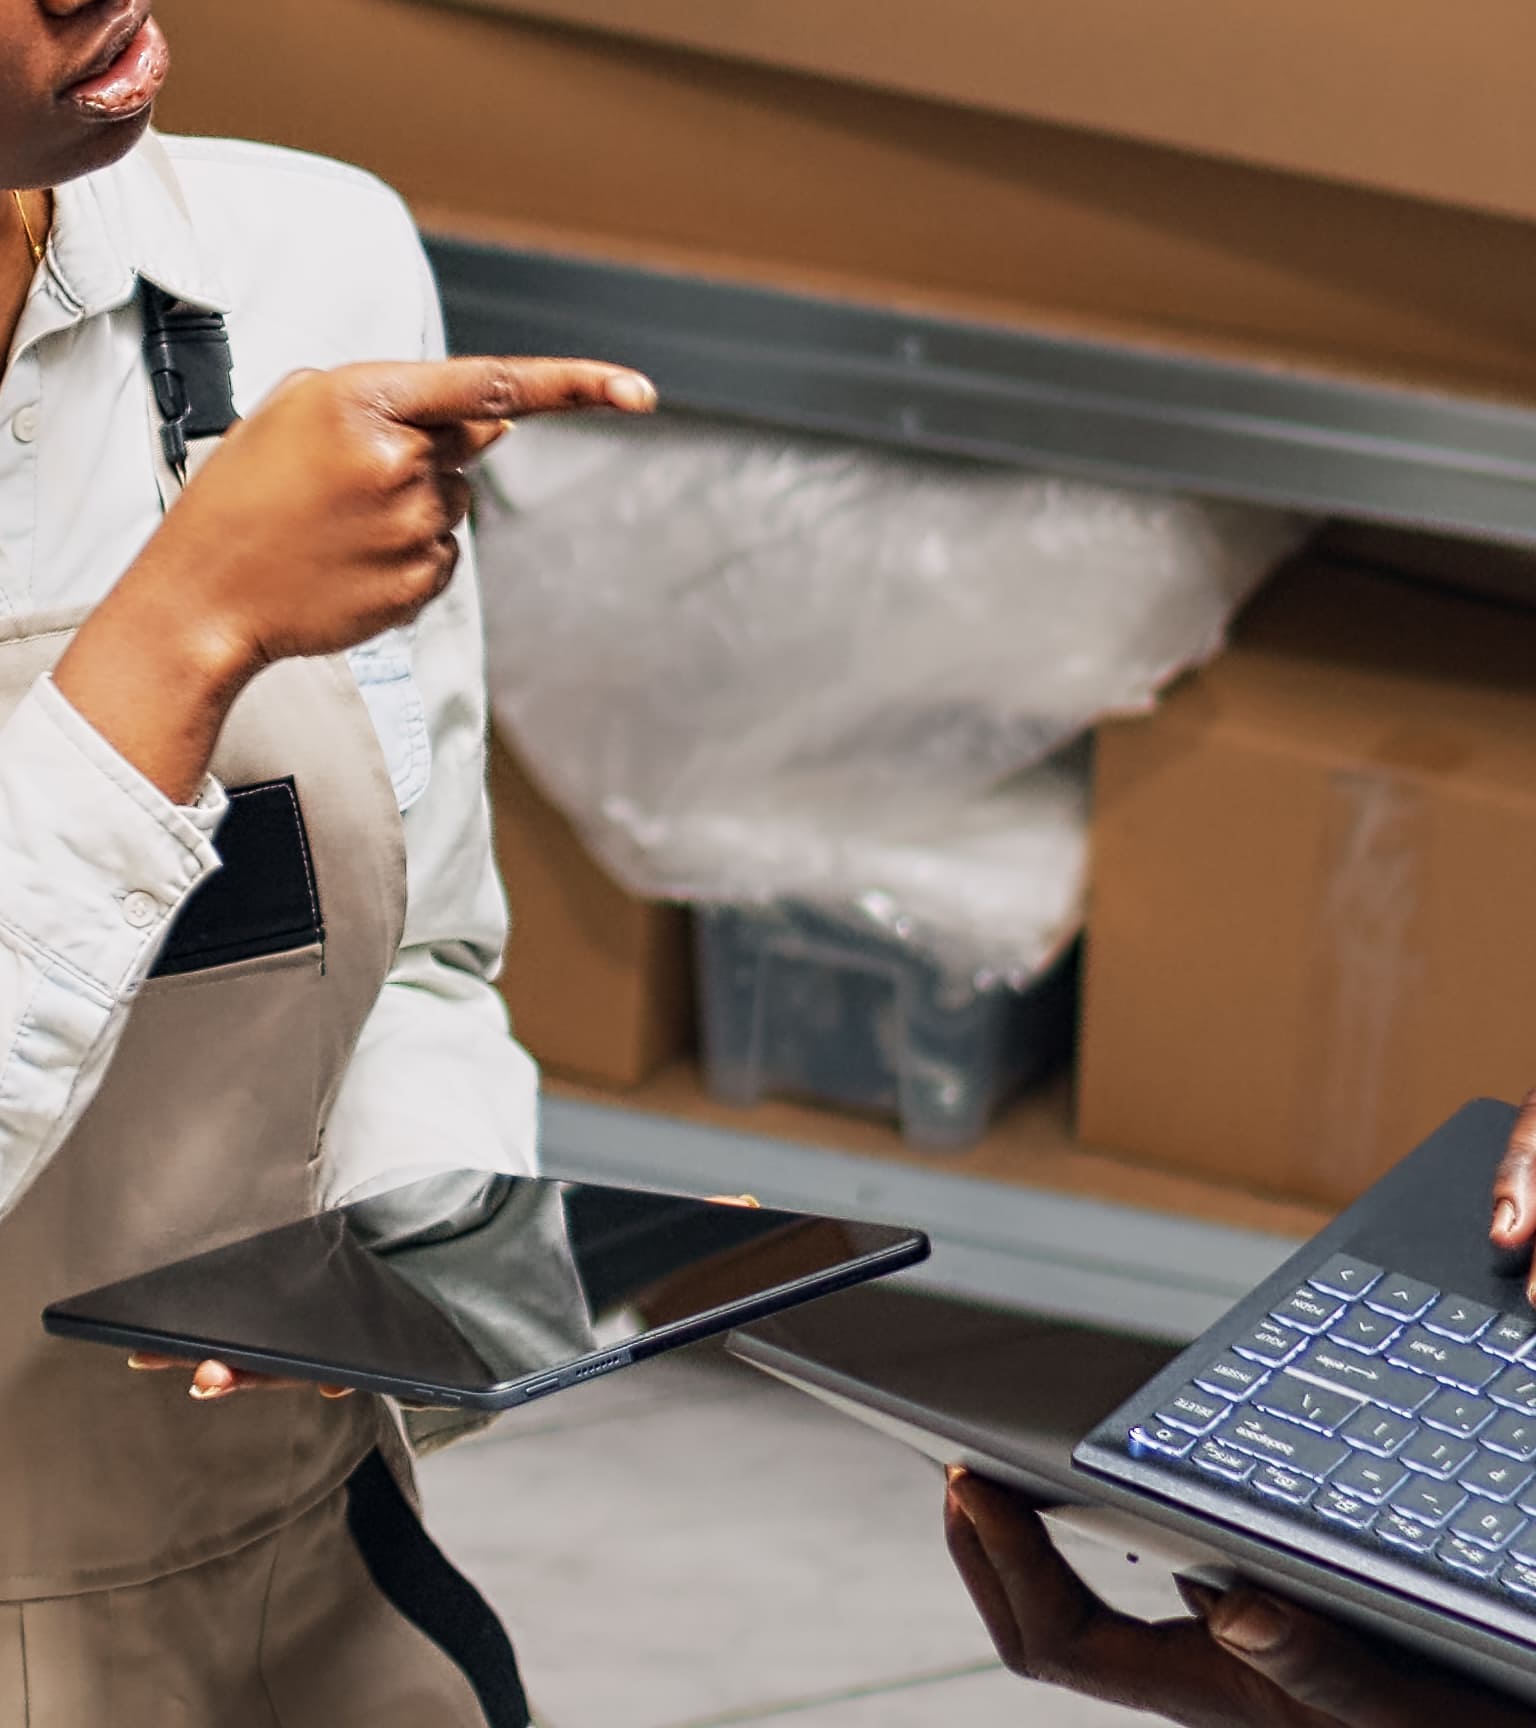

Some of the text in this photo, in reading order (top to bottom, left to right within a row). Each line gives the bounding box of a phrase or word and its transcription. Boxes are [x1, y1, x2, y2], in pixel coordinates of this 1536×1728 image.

[1292, 1299, 1325, 1315] PGDN
[1255, 1331, 1286, 1348] PGUP
[1213, 1365, 1254, 1385] INSERT
[1173, 1398, 1215, 1418] DELETE
[1235, 1425, 1294, 1457] backspace
[1489, 1470, 1506, 1481] P
